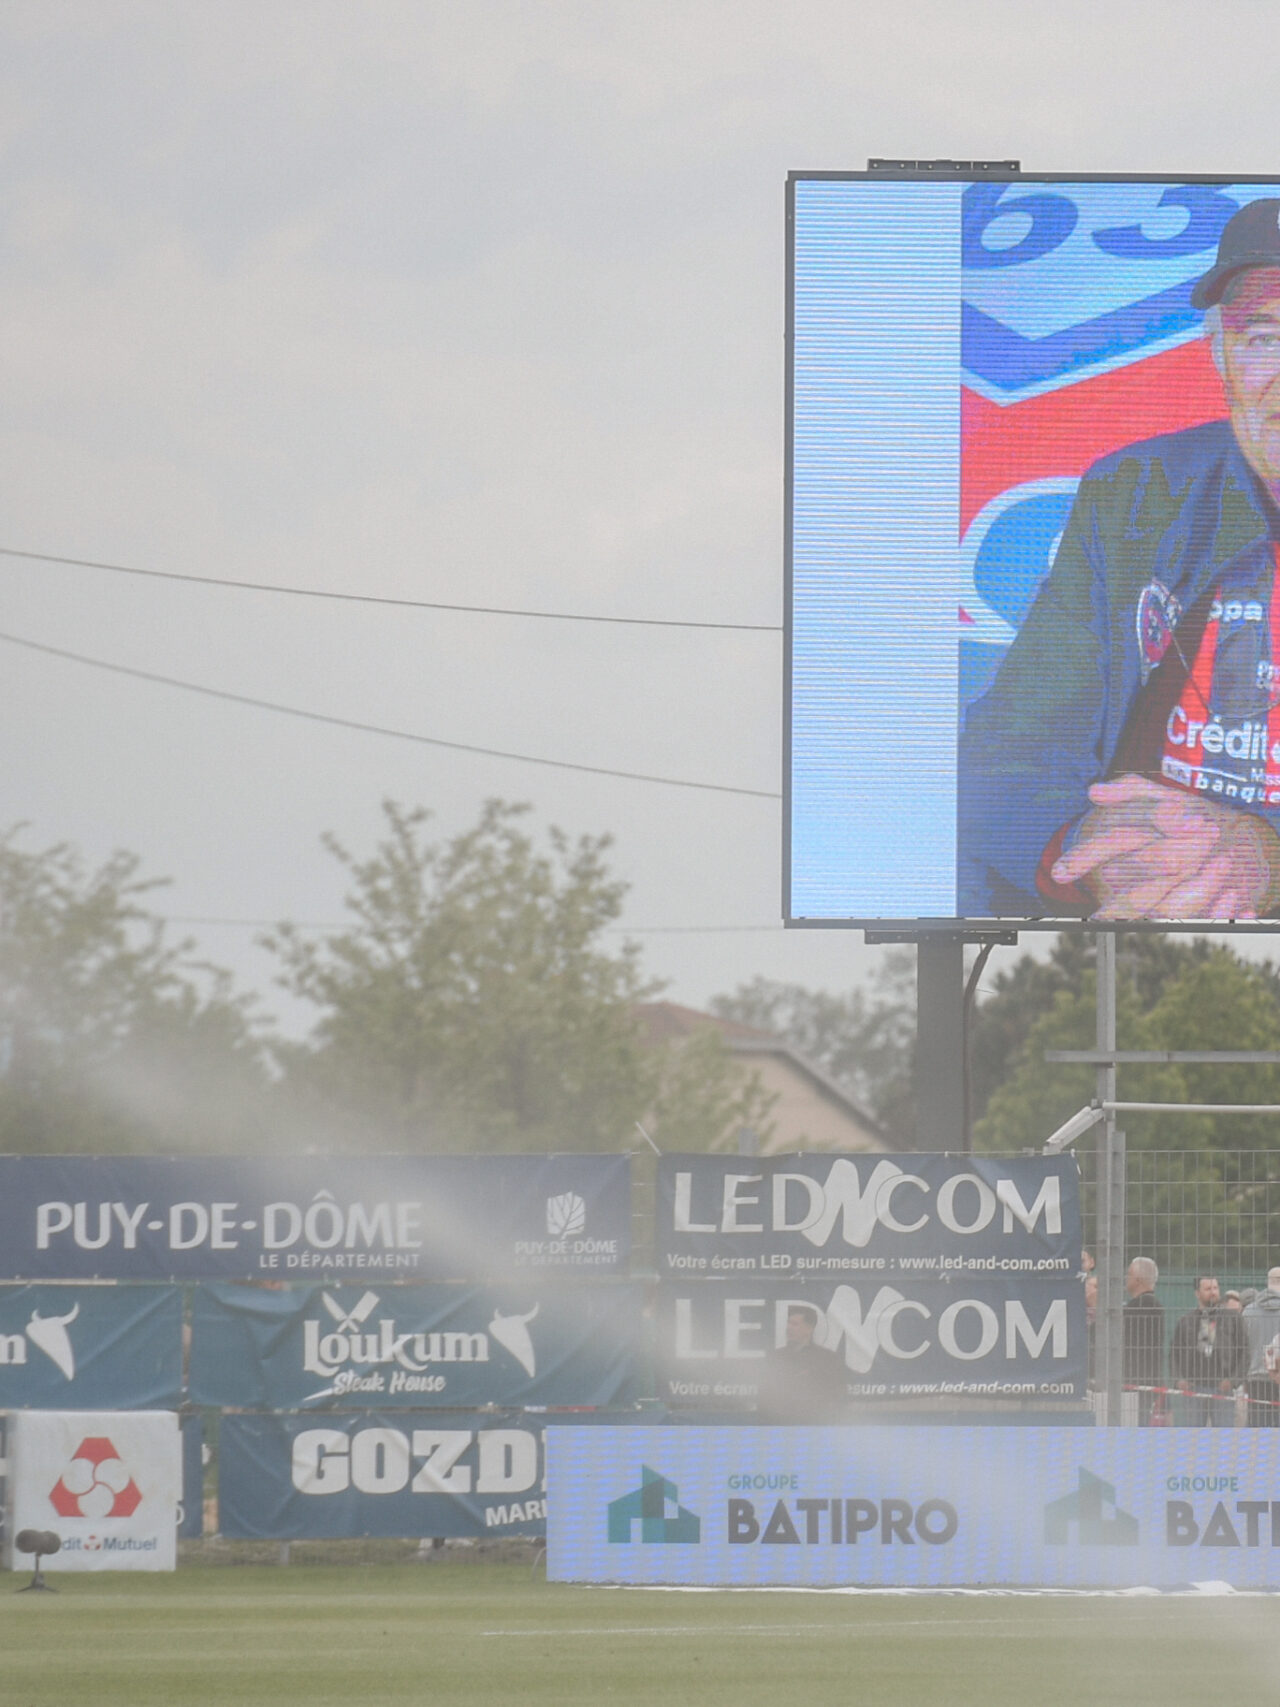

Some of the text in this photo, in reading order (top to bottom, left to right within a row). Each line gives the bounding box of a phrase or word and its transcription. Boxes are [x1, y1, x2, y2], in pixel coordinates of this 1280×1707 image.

[36, 1189, 423, 1249] PUY-DE-DÔME
[514, 1237, 618, 1255] PUY-DE-DÔME
[259, 1250, 421, 1269] LE DÉPARTEMENT
[667, 1253, 707, 1269] Votre
[711, 1254, 756, 1270] écran
[760, 1254, 792, 1269] LED
[796, 1256, 886, 1270] sur-mesure
[899, 1254, 1070, 1271] www.led-and-com.com
[303, 1319, 490, 1377] Loukum
[333, 1369, 447, 1395] Steak House
[669, 1380, 710, 1396] Votre
[899, 1380, 1075, 1395] www.led-and-com.com
[291, 1428, 547, 1495] GOZD
[727, 1474, 799, 1491] GROUPE
[1166, 1476, 1239, 1492] GROUPE
[727, 1498, 959, 1546] BATIPRO
[103, 1536, 158, 1551] Mutuel
